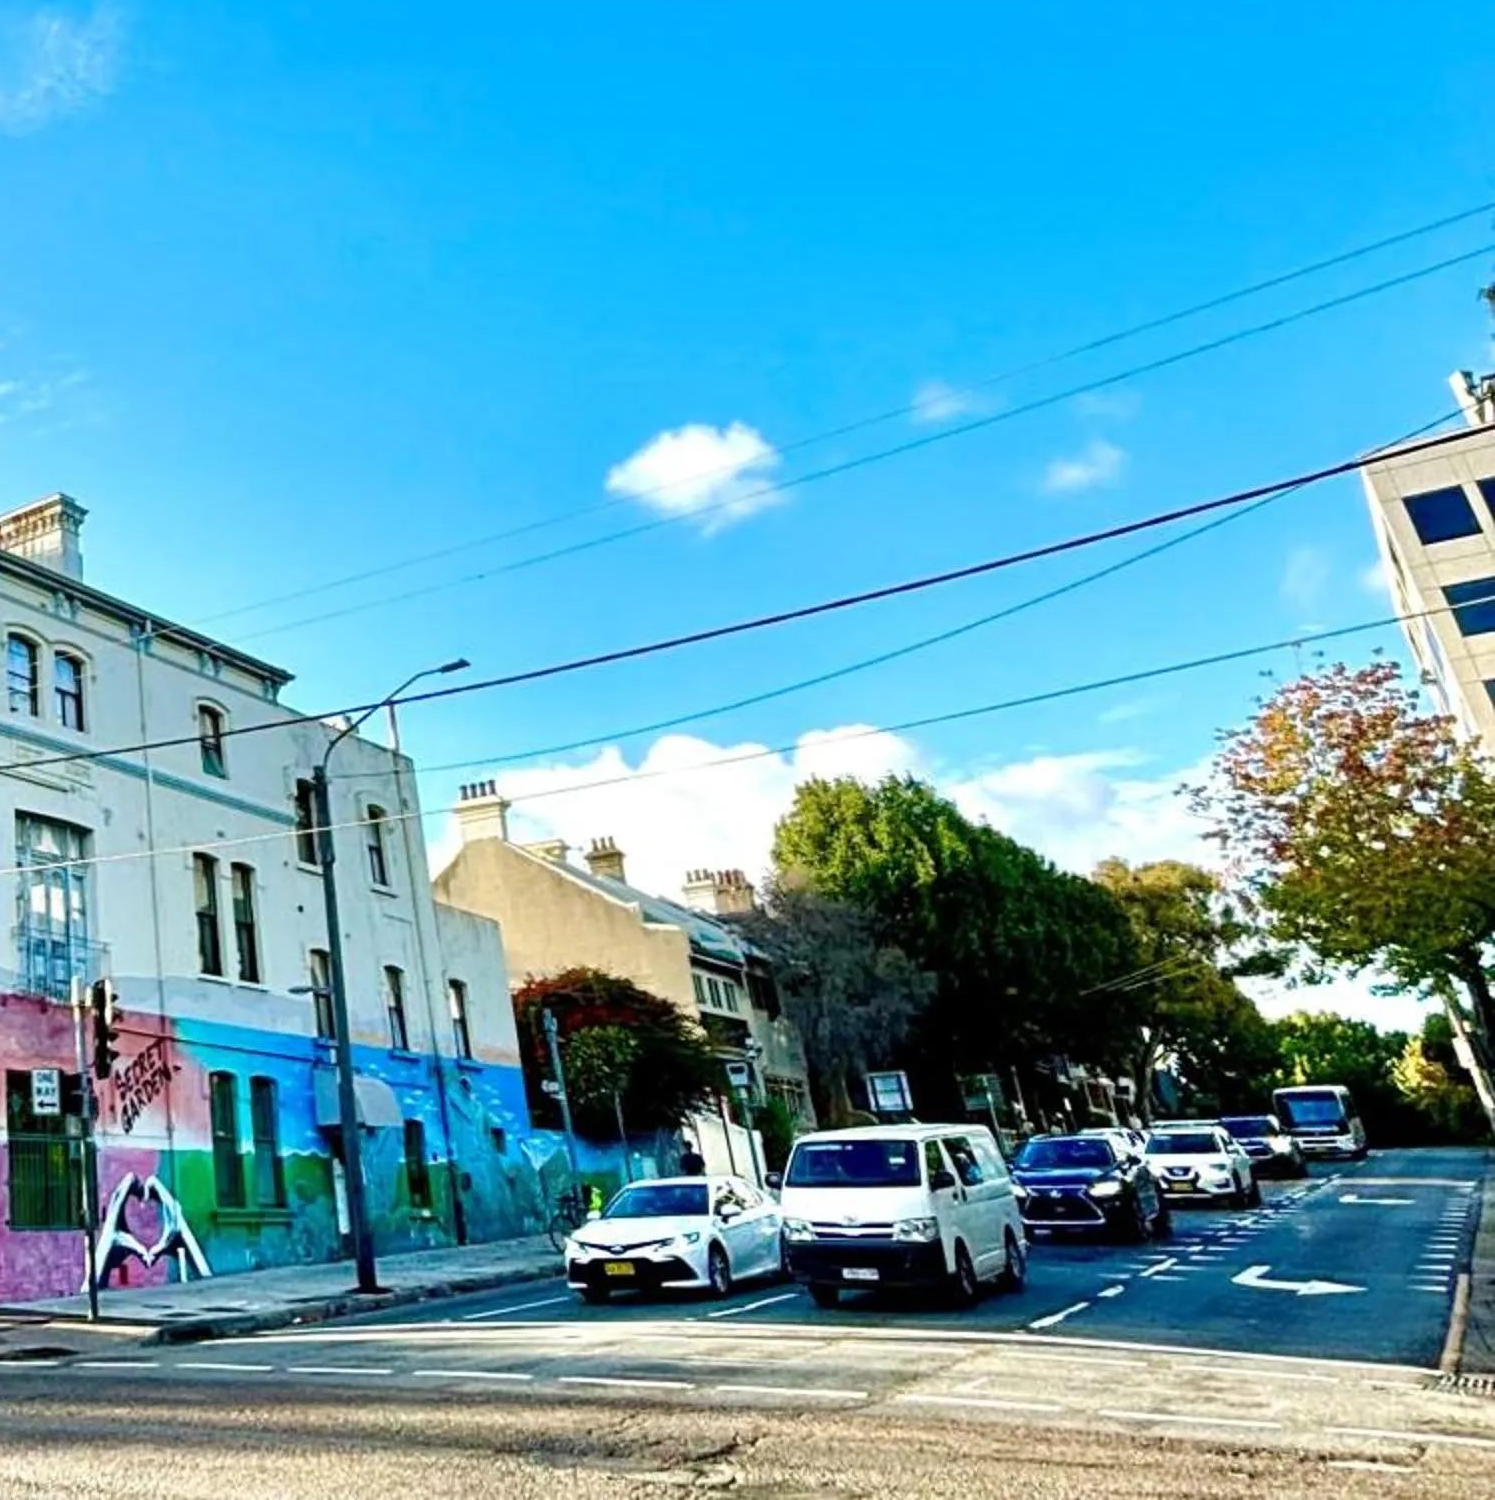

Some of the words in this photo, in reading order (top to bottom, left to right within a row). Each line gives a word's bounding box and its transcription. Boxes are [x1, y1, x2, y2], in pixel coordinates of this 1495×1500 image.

[36, 1072, 55, 1084] ONE
[115, 1038, 165, 1100] SECRET
[36, 1086, 55, 1096] WAY
[121, 1062, 172, 1134] GARDEN
